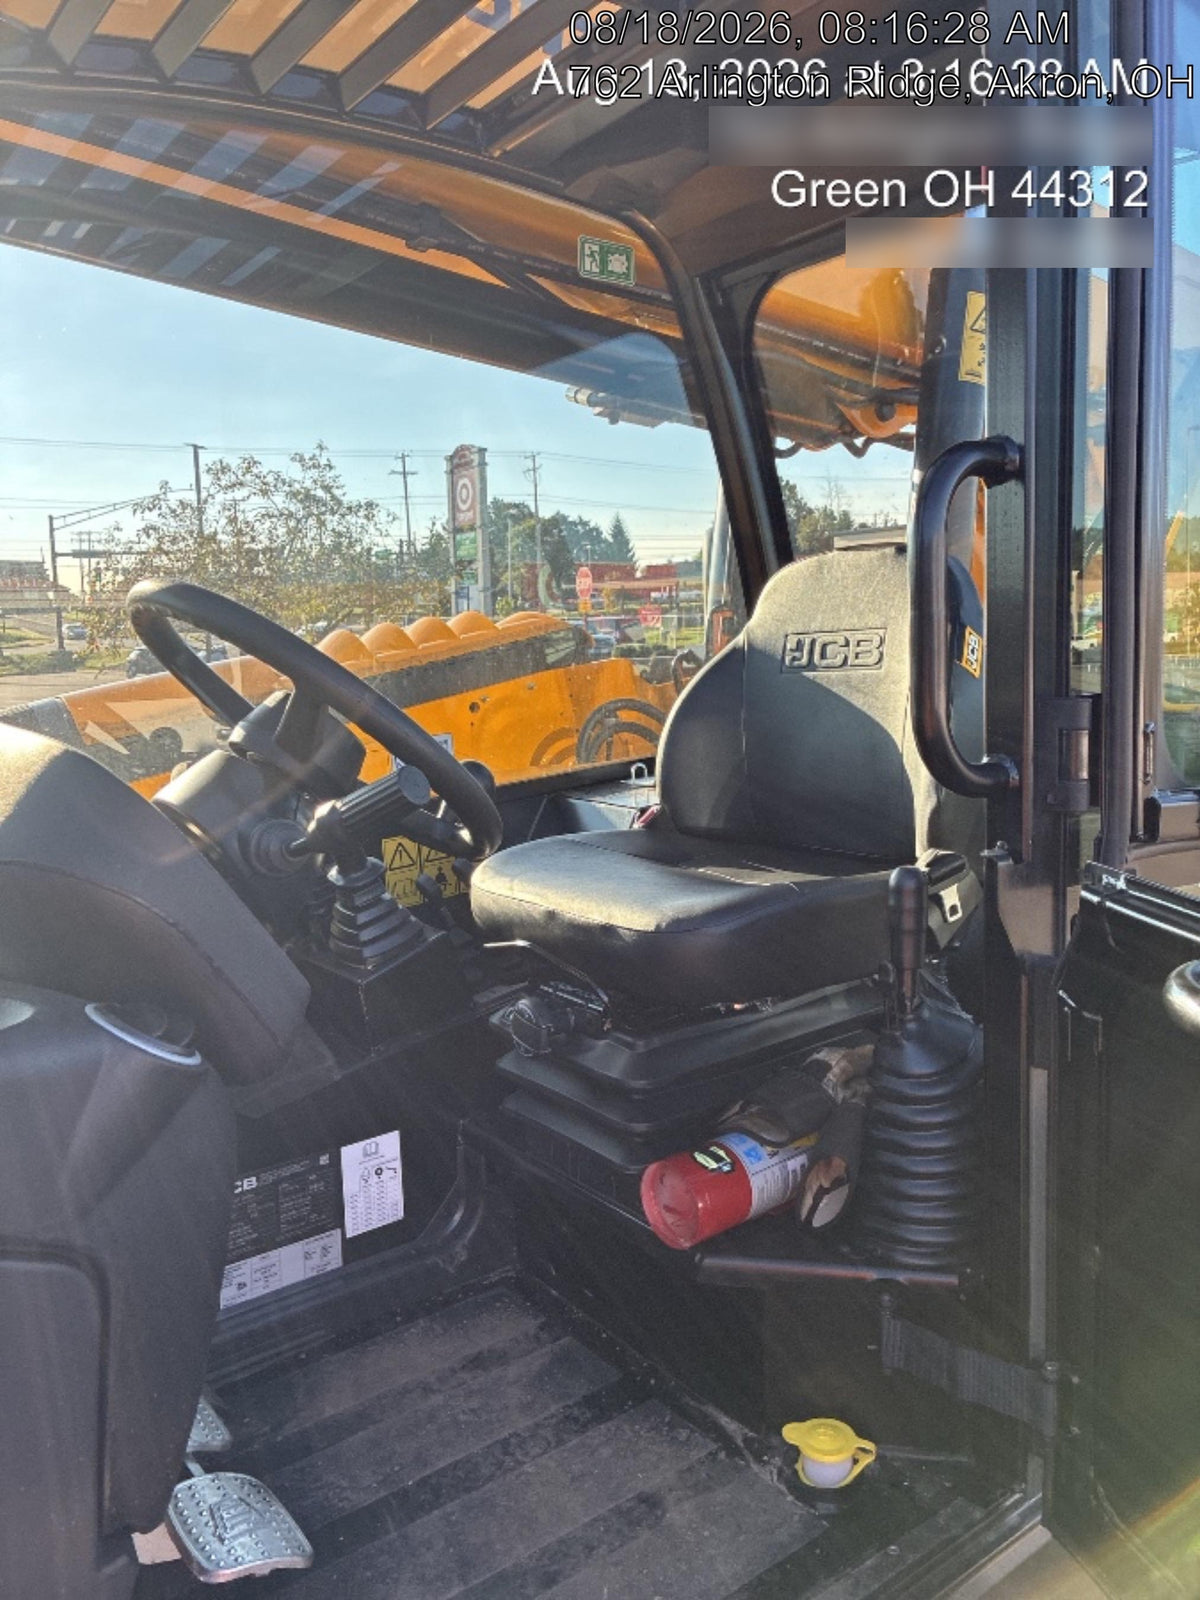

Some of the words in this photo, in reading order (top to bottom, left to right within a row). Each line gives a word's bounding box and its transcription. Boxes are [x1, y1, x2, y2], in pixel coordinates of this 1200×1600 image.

[784, 633, 883, 669] JCB
[967, 632, 979, 669] JCB
[233, 1176, 258, 1194] CB
